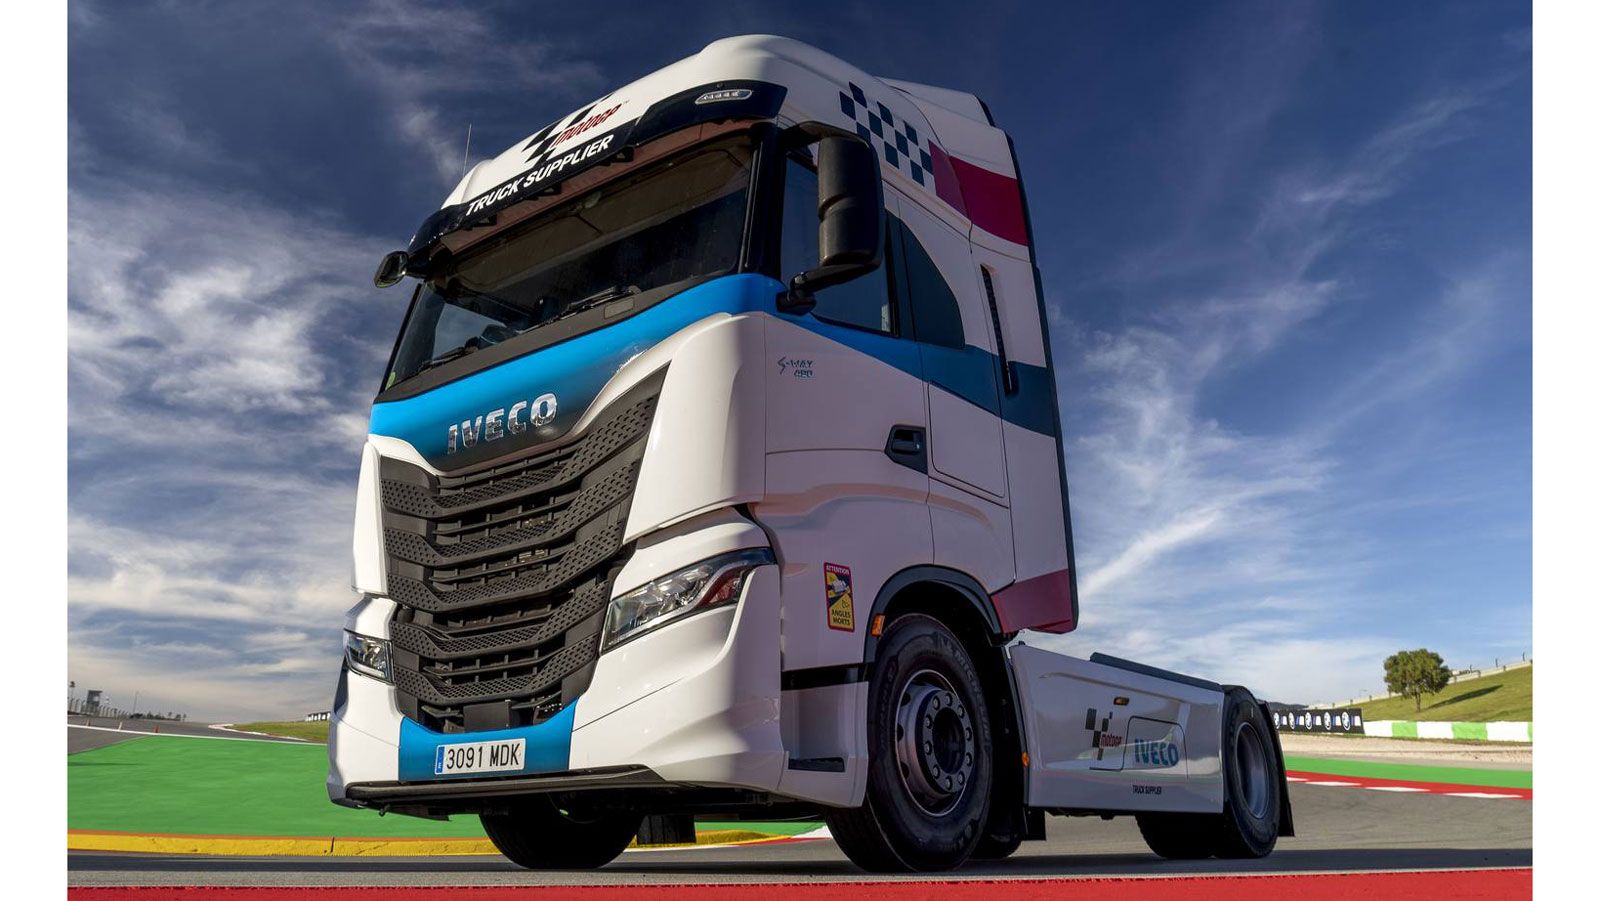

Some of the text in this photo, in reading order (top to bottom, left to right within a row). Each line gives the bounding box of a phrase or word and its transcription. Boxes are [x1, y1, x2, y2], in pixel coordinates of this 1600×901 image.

[465, 134, 615, 217] TRUCK SUPPLIER
[447, 393, 558, 455] IVECO
[826, 565, 850, 575] ATTENTION
[832, 609, 851, 619] ANGLES
[833, 617, 850, 626] MORTS
[446, 746, 483, 769] 3091
[489, 743, 520, 767] MDK
[1134, 738, 1179, 767] IVECO
